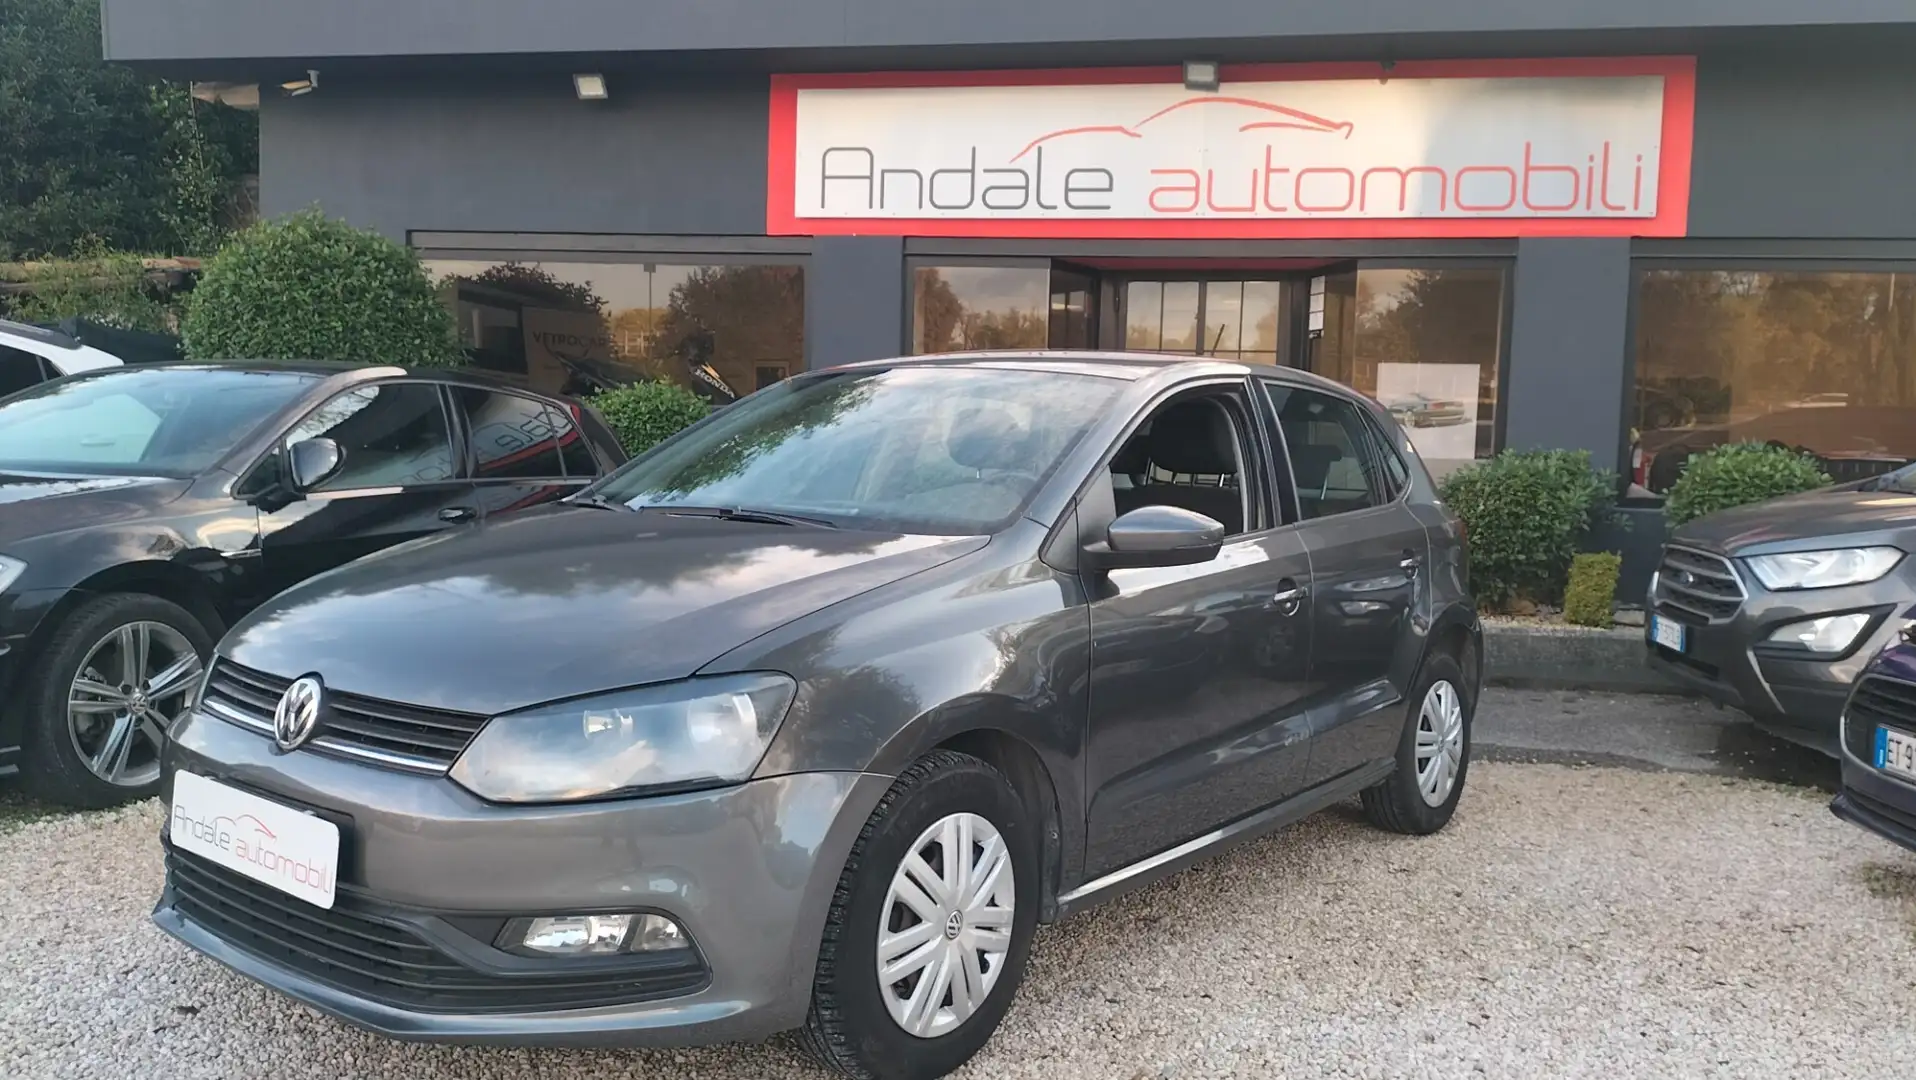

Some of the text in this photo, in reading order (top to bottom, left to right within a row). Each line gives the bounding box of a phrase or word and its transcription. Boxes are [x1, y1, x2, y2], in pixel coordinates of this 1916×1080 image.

[820, 139, 1641, 212] Andale automobili
[695, 369, 735, 399] HONDA
[173, 804, 333, 894] Andale automobili
